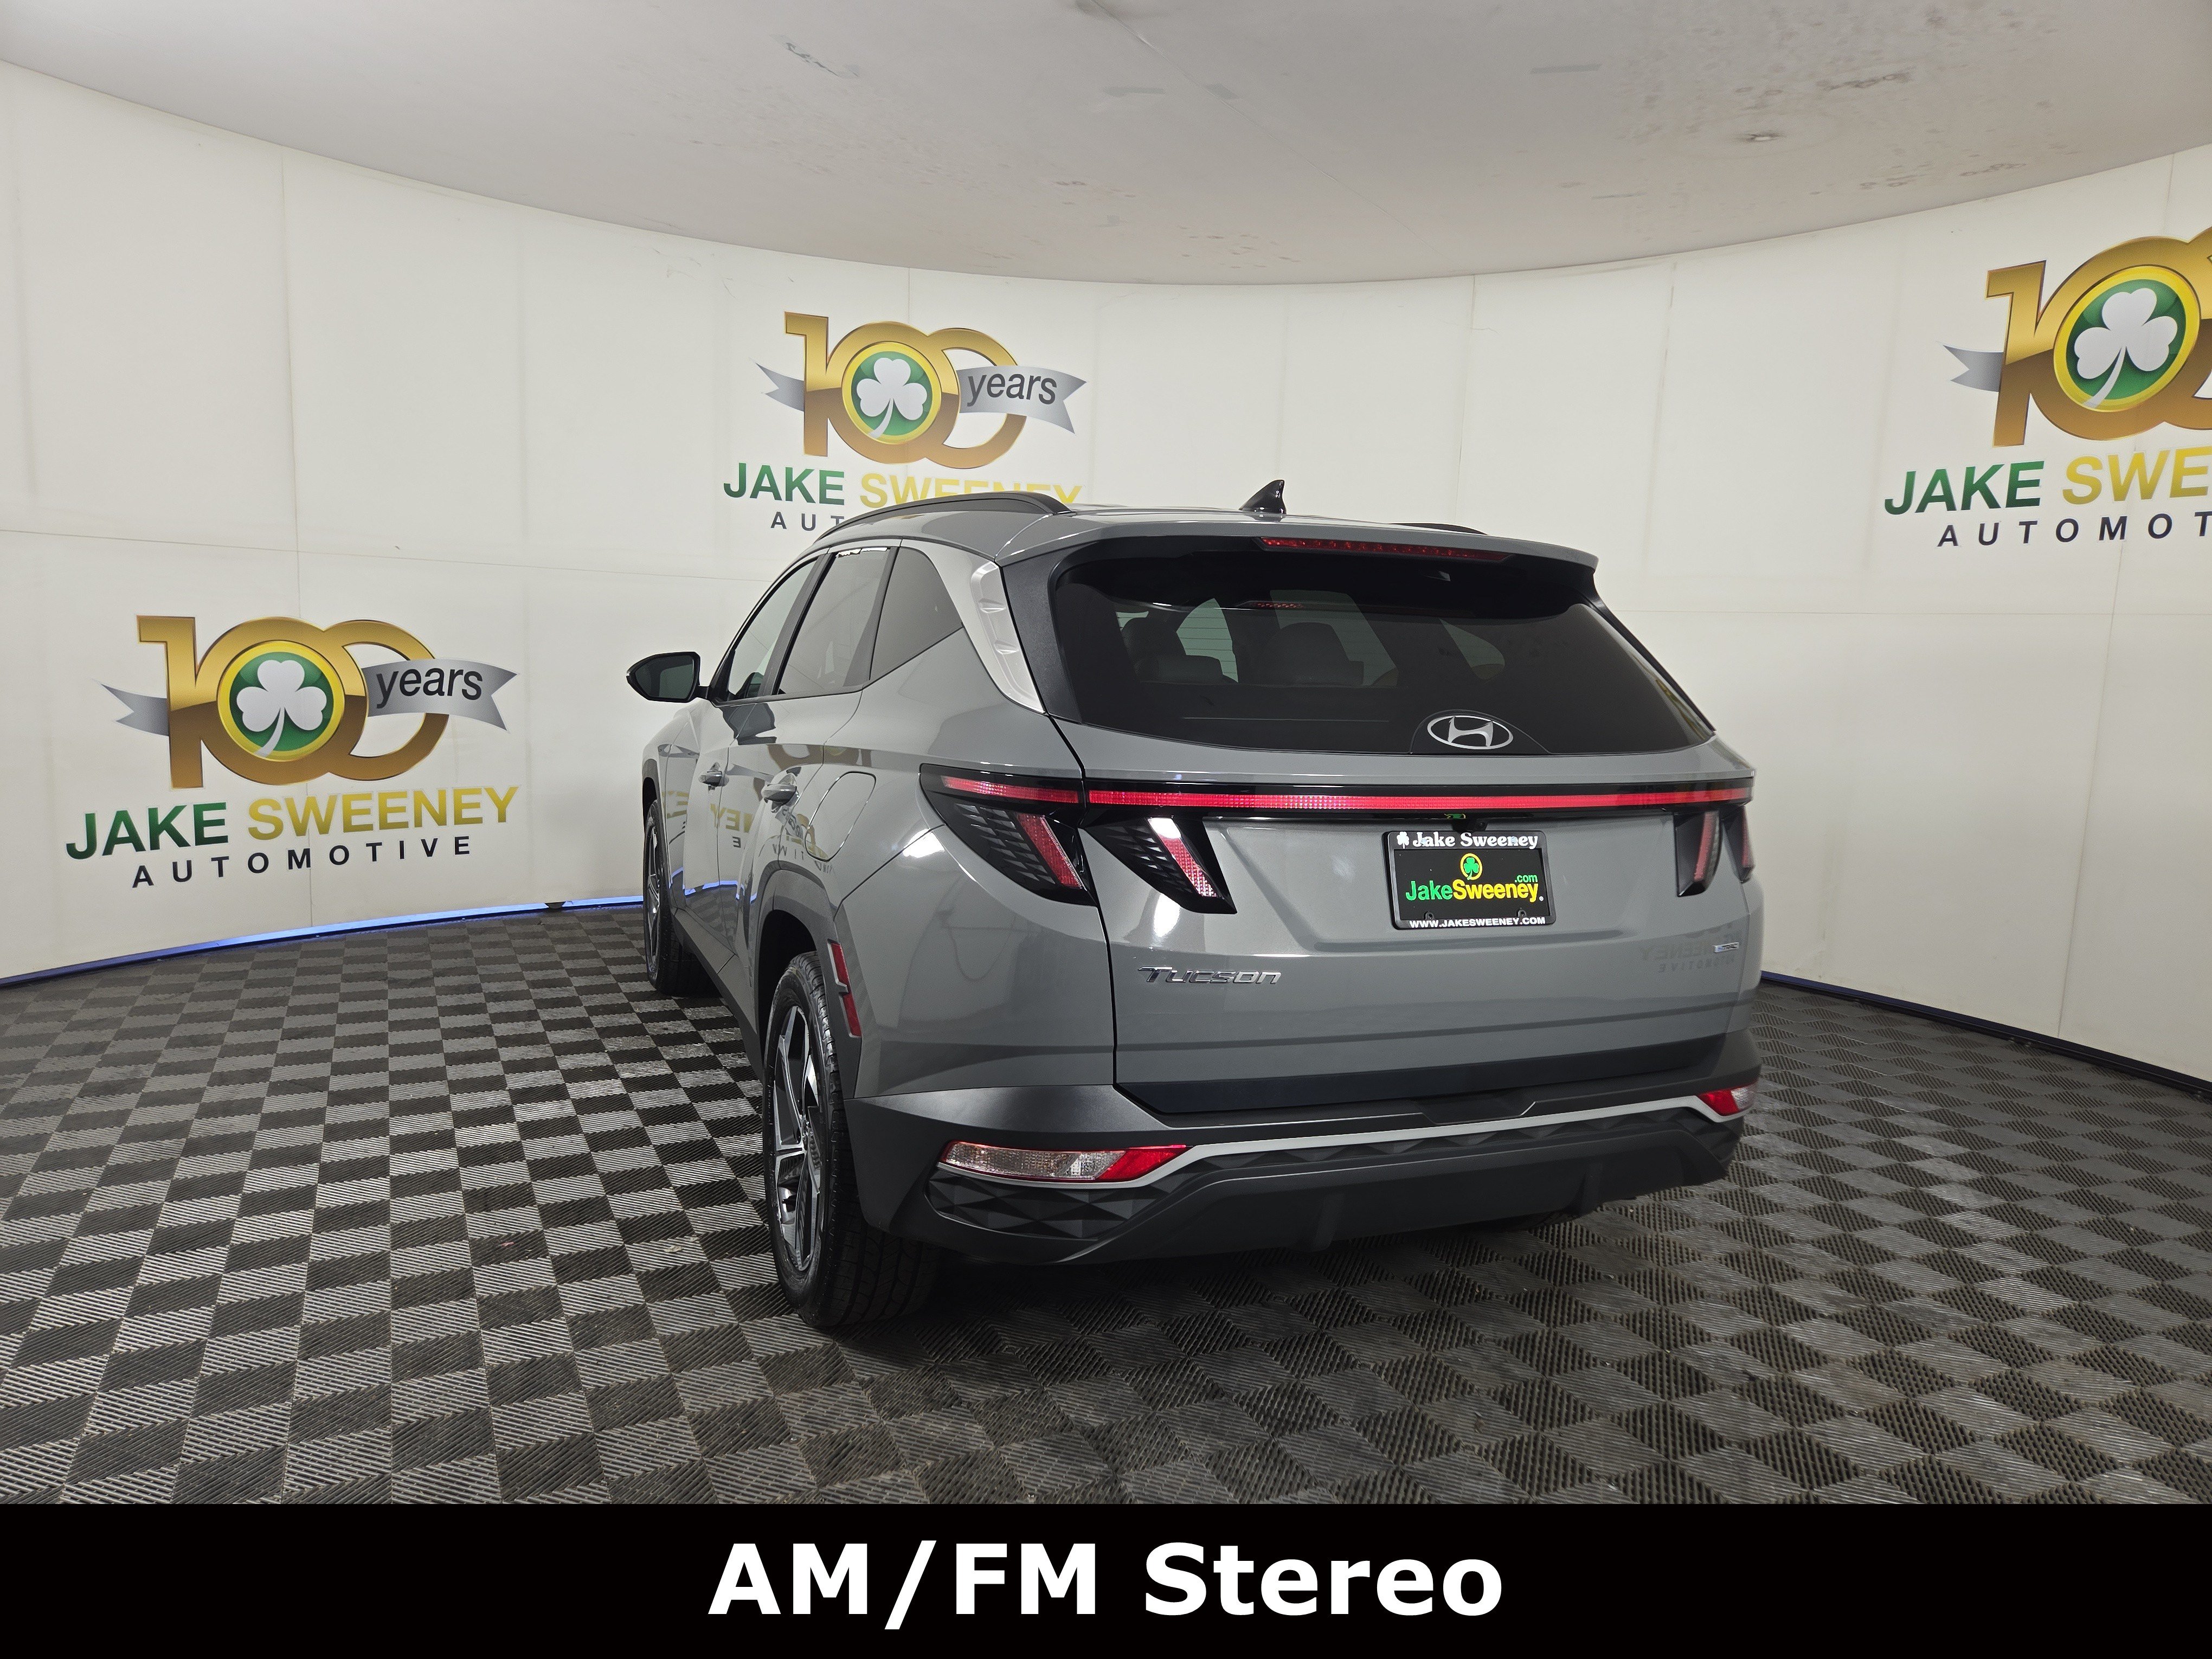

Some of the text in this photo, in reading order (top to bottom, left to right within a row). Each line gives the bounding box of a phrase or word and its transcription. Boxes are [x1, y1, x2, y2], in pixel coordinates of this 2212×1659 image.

[967, 372, 1057, 407] years
[723, 462, 845, 506] JAKE
[1885, 461, 2044, 515] JAKE
[376, 667, 483, 710] years
[66, 786, 519, 860] JAKE SWEENEY
[1413, 832, 1538, 850] Jake Sweeney
[132, 836, 470, 888] AUTOMOTIVE
[1410, 917, 1546, 928] WWW.JAKESWEENEY.COM
